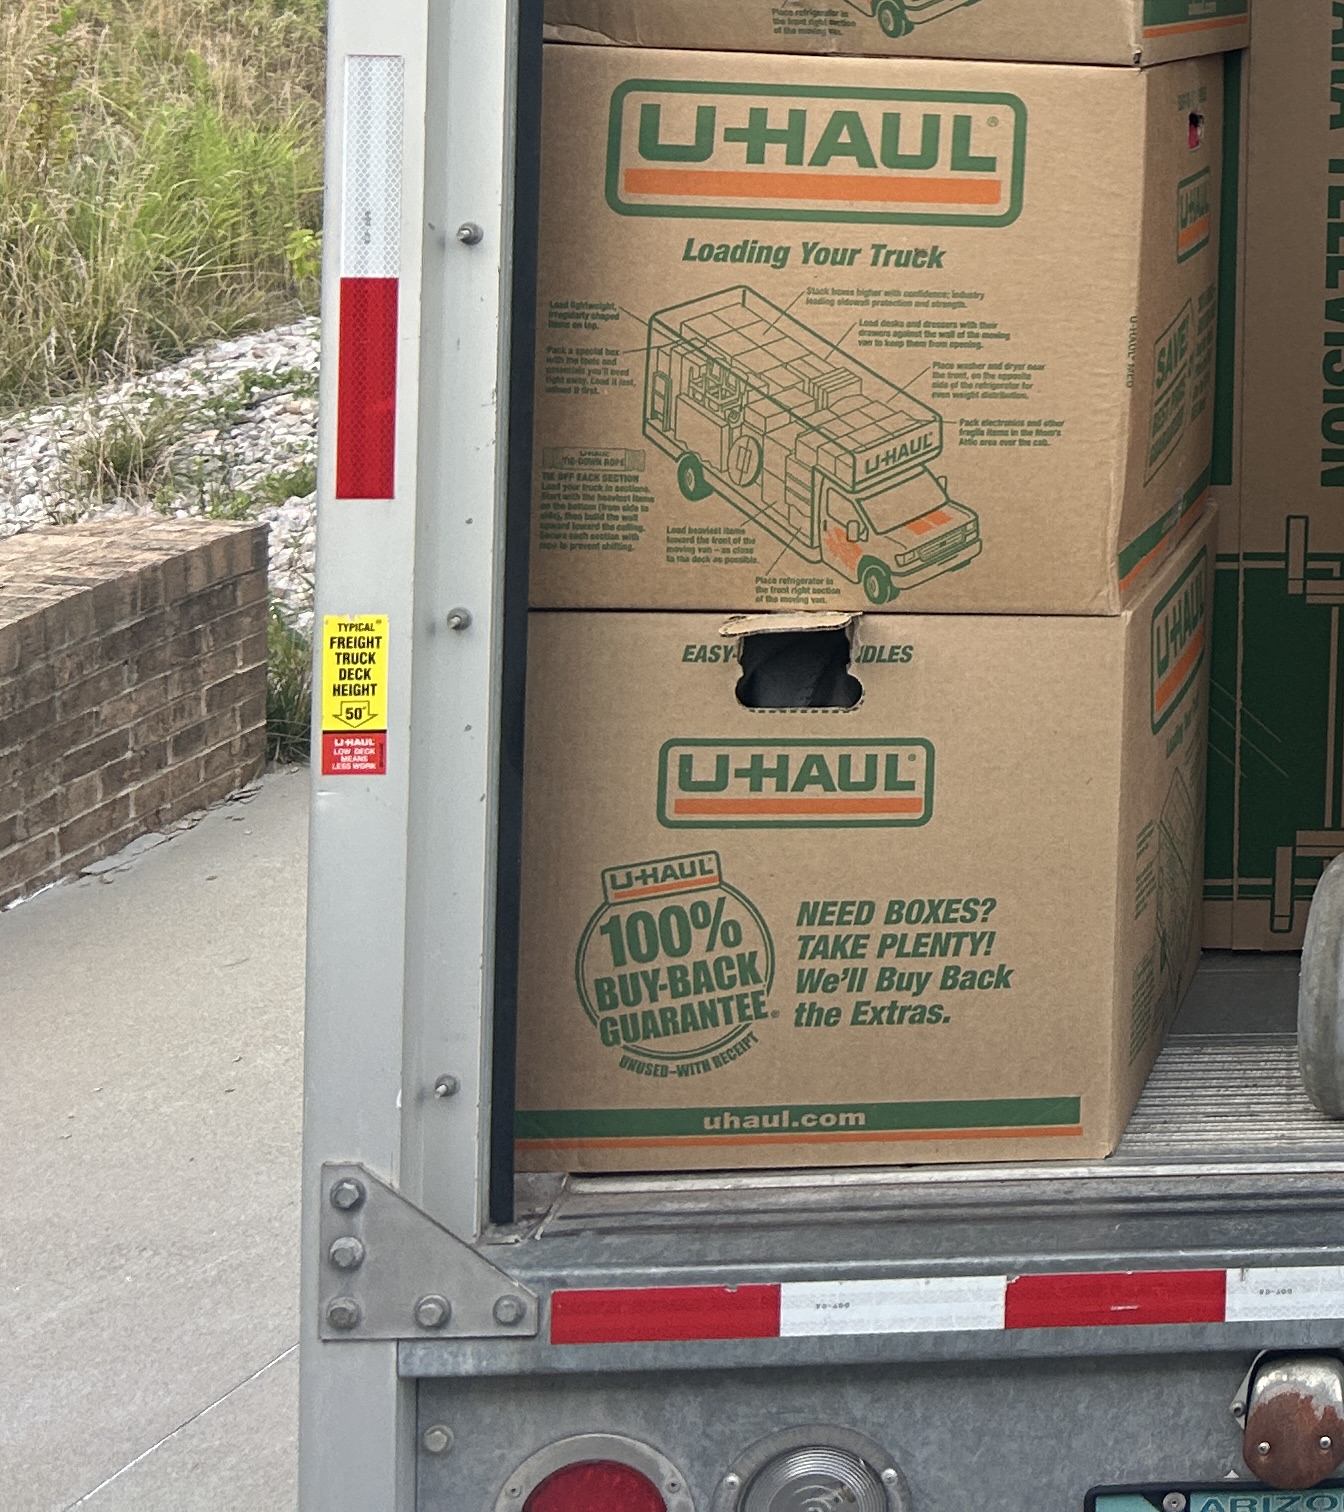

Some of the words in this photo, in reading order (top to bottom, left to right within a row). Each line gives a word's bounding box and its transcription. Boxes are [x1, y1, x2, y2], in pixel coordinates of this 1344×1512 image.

[639, 103, 997, 173] U-HAUL
[683, 238, 790, 269] Loading
[800, 242, 861, 269] Your
[869, 244, 946, 270] Truck
[864, 432, 935, 477] U-HAUL
[666, 526, 685, 534] Load
[688, 526, 722, 535] heaviest
[666, 546, 696, 554] moving
[755, 576, 777, 585] Place
[779, 577, 824, 585] refrigerator
[770, 586, 789, 594] front
[791, 586, 810, 595] right
[338, 623, 375, 631] TYPICAL
[330, 636, 382, 649] FREIGHT
[335, 652, 376, 665] TRUCK
[339, 668, 371, 680] DECK
[332, 684, 377, 696] HEIGHT
[678, 754, 915, 792] U-HAUL
[610, 857, 714, 890] U-HAUL
[796, 900, 875, 927] NEED
[884, 897, 997, 926] BOXES?
[600, 896, 742, 967] 100%
[798, 934, 870, 960] TAKE
[876, 931, 997, 959] PLENTY!
[594, 950, 763, 1012] BUY-BACK
[796, 967, 868, 994] We'll
[875, 967, 932, 996] Buy
[939, 964, 1014, 990] Back
[599, 990, 769, 1047] GUARANTEE
[794, 1000, 842, 1028] the
[850, 1000, 951, 1026] Extras.
[713, 1031, 759, 1070] RECEIPT
[703, 1109, 866, 1130] uhaul.com
